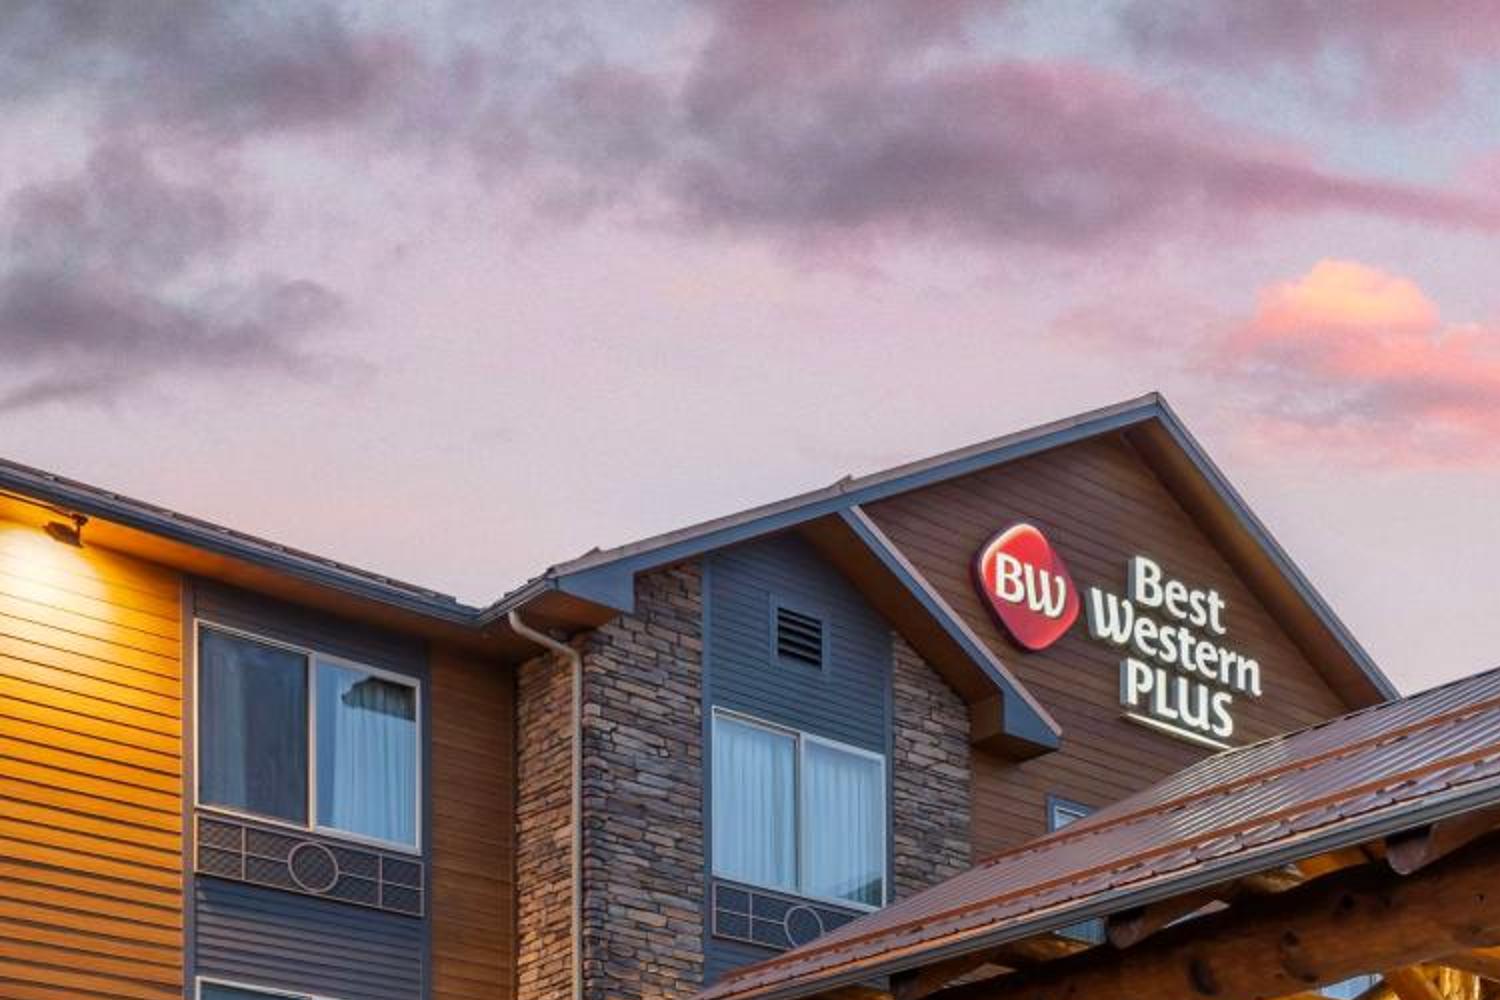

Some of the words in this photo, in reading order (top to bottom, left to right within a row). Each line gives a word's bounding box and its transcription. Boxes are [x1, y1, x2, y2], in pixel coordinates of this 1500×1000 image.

[995, 553, 1067, 618] BW
[1133, 555, 1227, 635] Best
[1090, 586, 1262, 697] Western
[1126, 657, 1234, 738] PLUS
